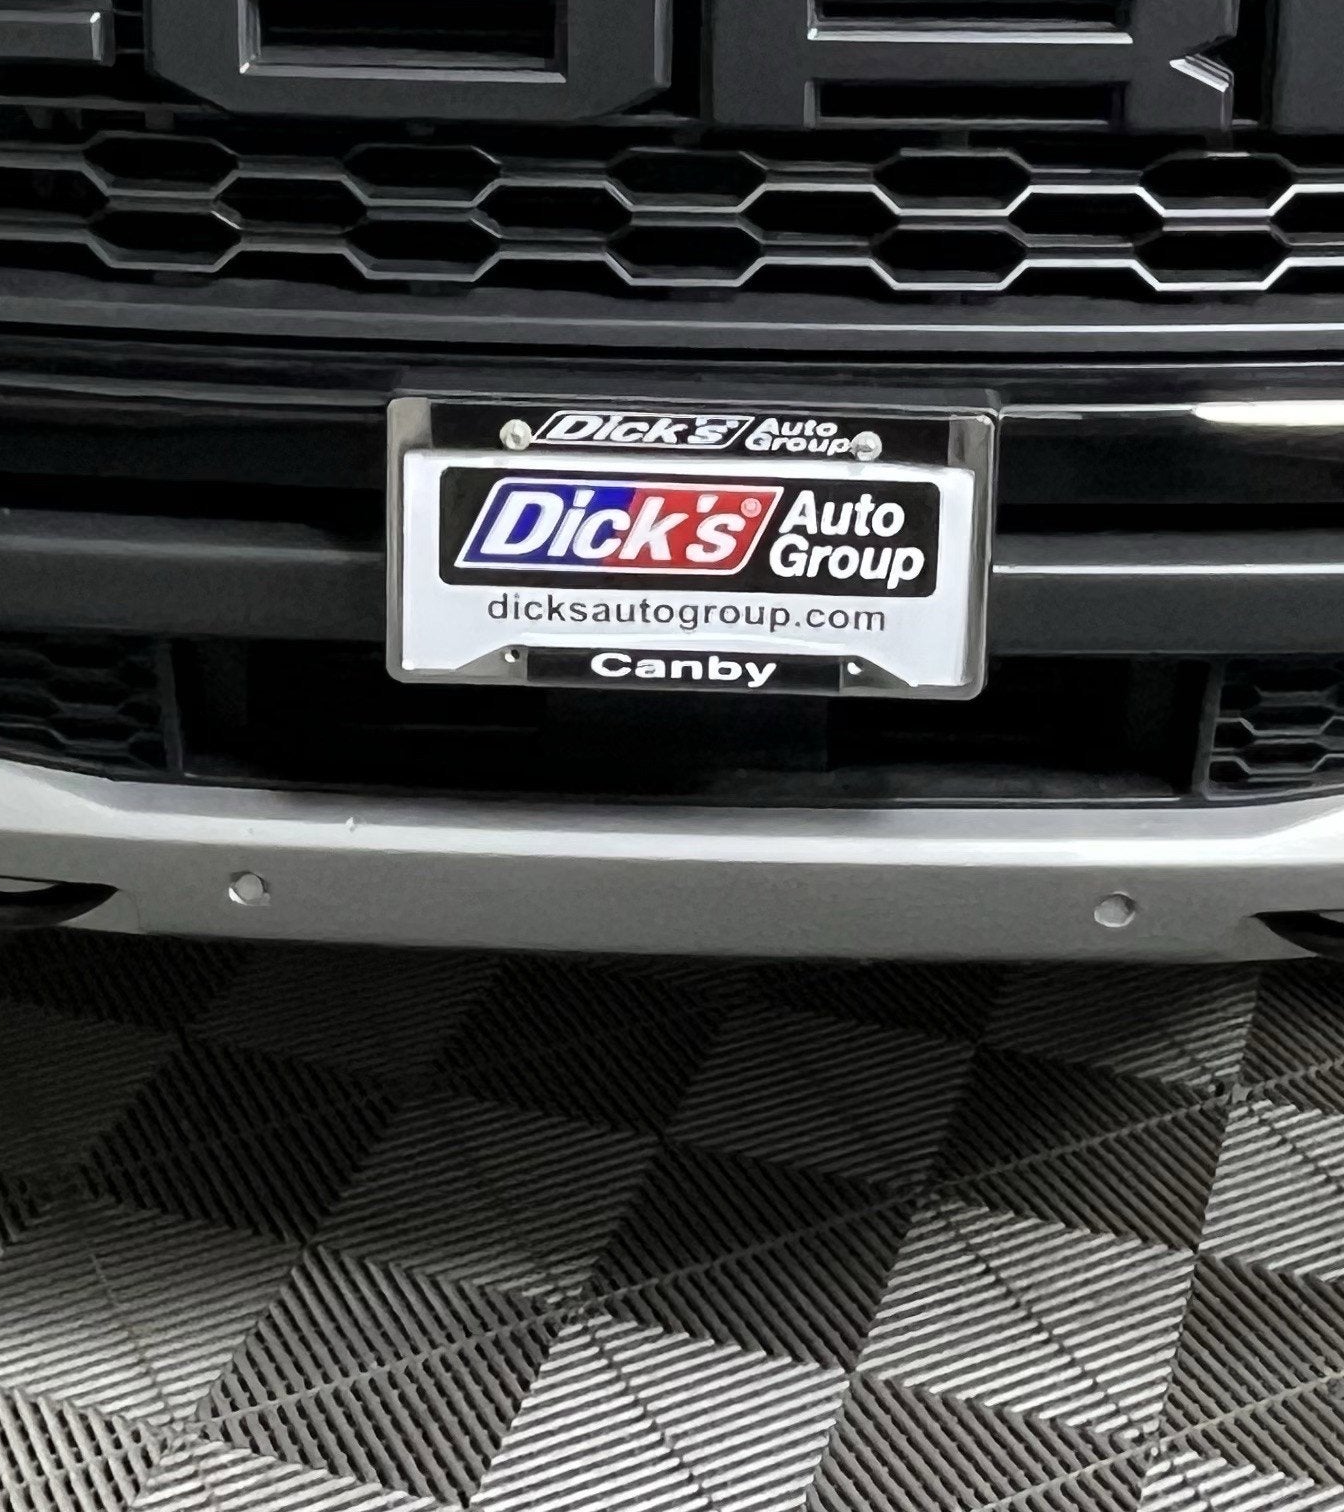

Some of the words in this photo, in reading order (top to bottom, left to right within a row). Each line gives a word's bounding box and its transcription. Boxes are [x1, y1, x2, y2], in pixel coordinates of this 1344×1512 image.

[544, 414, 740, 445] Dick's
[744, 435, 855, 457] Group
[757, 417, 839, 437] Auto
[479, 486, 747, 564] Dick's
[778, 489, 906, 537] Auto
[768, 532, 925, 591] Group
[486, 592, 887, 632] dicksautogroup.com
[589, 651, 778, 688] Canby
